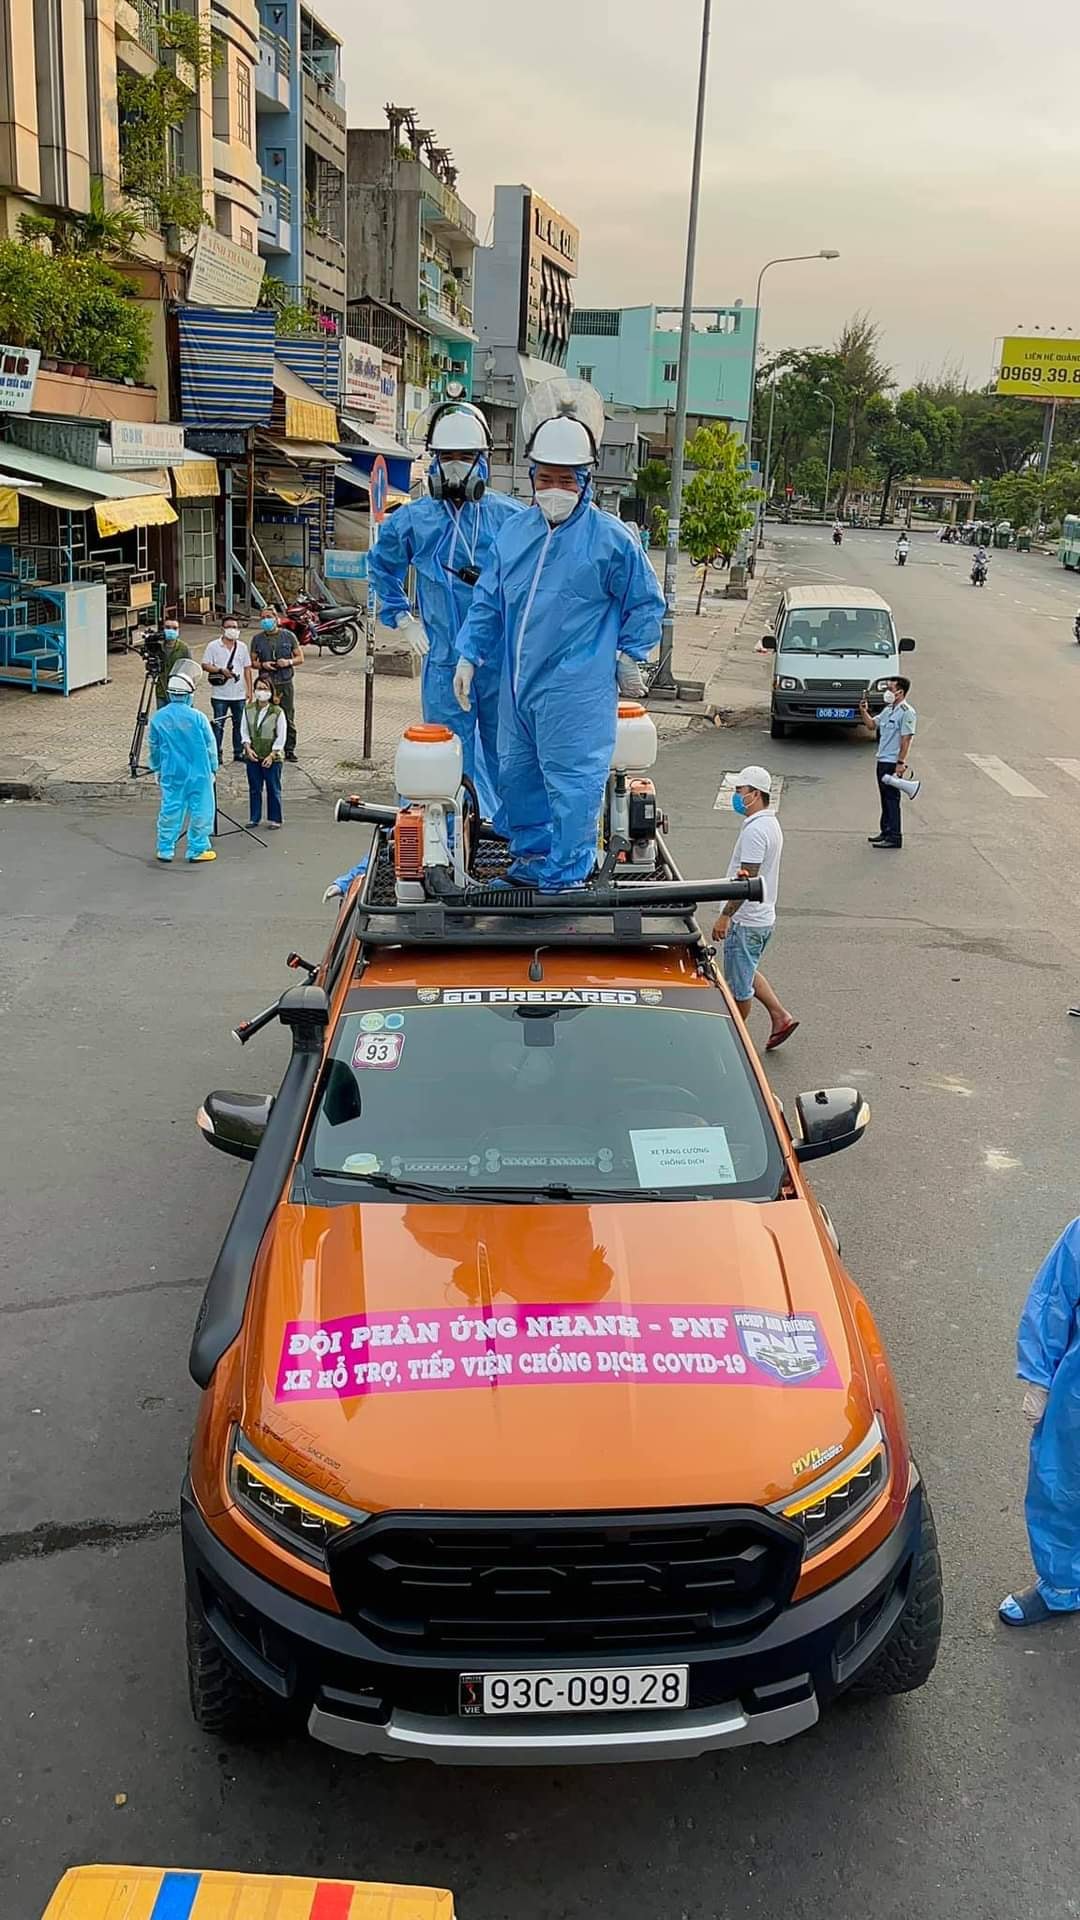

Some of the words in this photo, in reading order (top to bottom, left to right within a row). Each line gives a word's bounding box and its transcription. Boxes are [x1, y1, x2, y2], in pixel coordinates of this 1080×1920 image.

[1025, 352, 1042, 361] LIÊN
[1001, 366, 1080, 383] 0969.39.8
[443, 991, 482, 1004] GO
[489, 990, 637, 1004] PREPARED
[366, 1044, 388, 1061] 93
[288, 1329, 343, 1361] ĐỘI
[350, 1315, 440, 1350] PHẢN
[449, 1314, 517, 1343] ỨNG
[525, 1314, 641, 1339] NHANH
[669, 1316, 729, 1339] PNF
[283, 1369, 312, 1391] XE
[316, 1355, 348, 1389] HỖ
[354, 1360, 402, 1387] TRỢ,
[407, 1350, 455, 1381] TIẾP
[460, 1350, 513, 1381] VIỆN
[518, 1344, 592, 1374] CHỐNG
[596, 1351, 648, 1378] DỊCH
[652, 1352, 746, 1375] COVID-19
[791, 1447, 821, 1475] MVM
[490, 1672, 680, 1709] 93C-099.28
[464, 1705, 481, 1714] VIE
